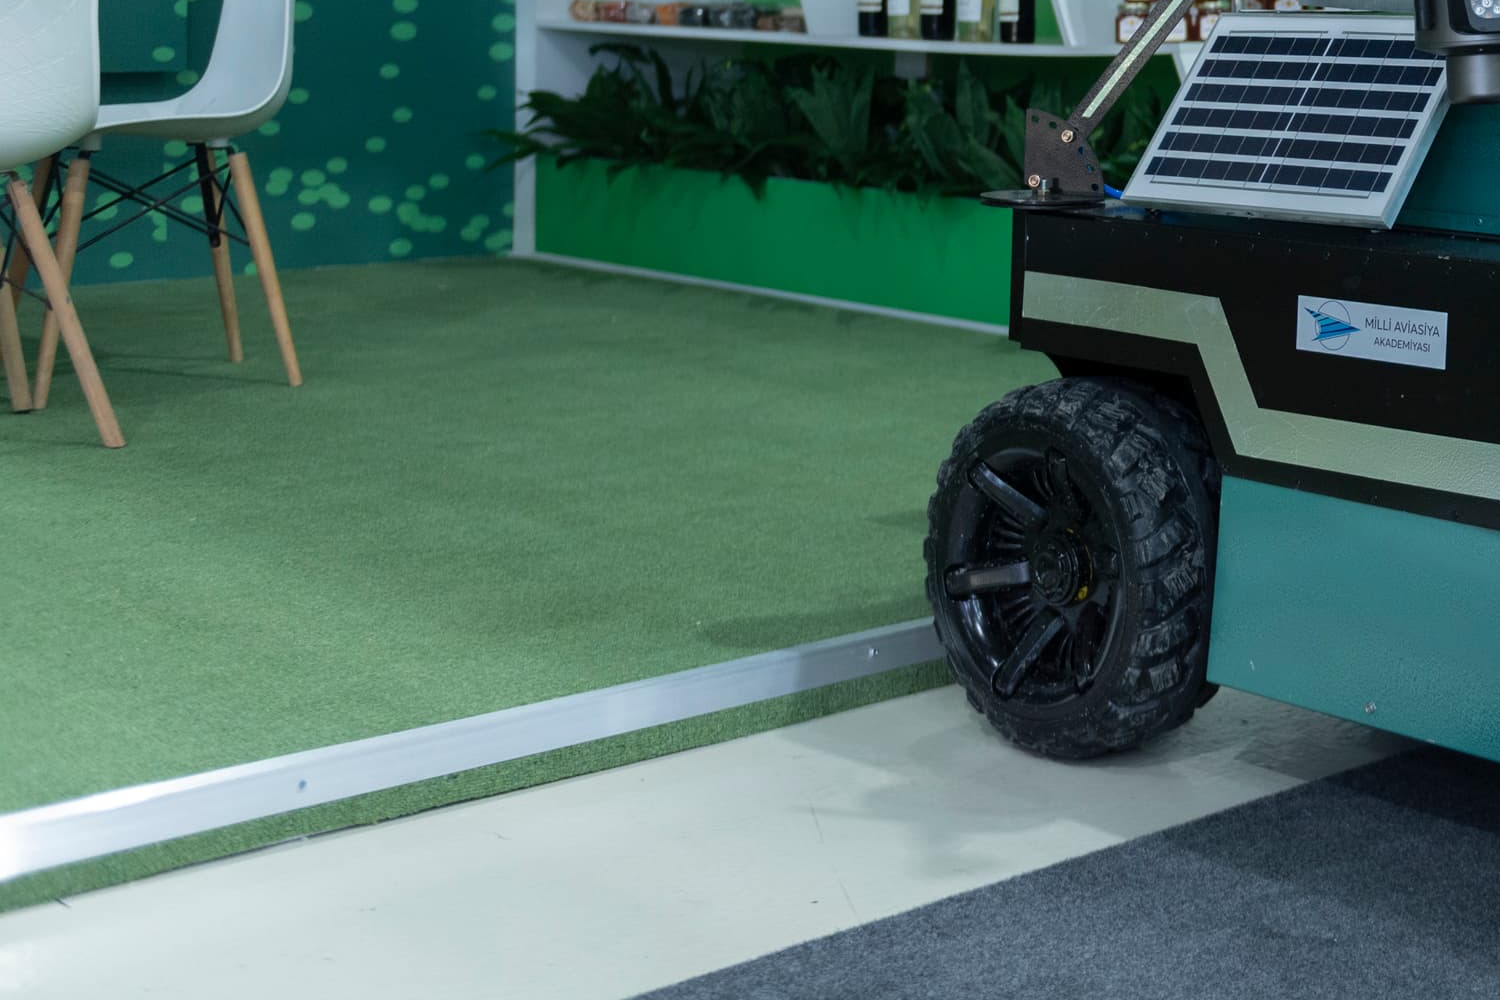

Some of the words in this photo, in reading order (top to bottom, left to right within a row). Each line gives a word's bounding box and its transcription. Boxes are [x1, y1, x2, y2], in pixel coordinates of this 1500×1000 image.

[1365, 316, 1392, 331] MİLLİ
[1394, 320, 1440, 337] AVİASİYA
[1374, 337, 1431, 352] AKADEMİYASI
